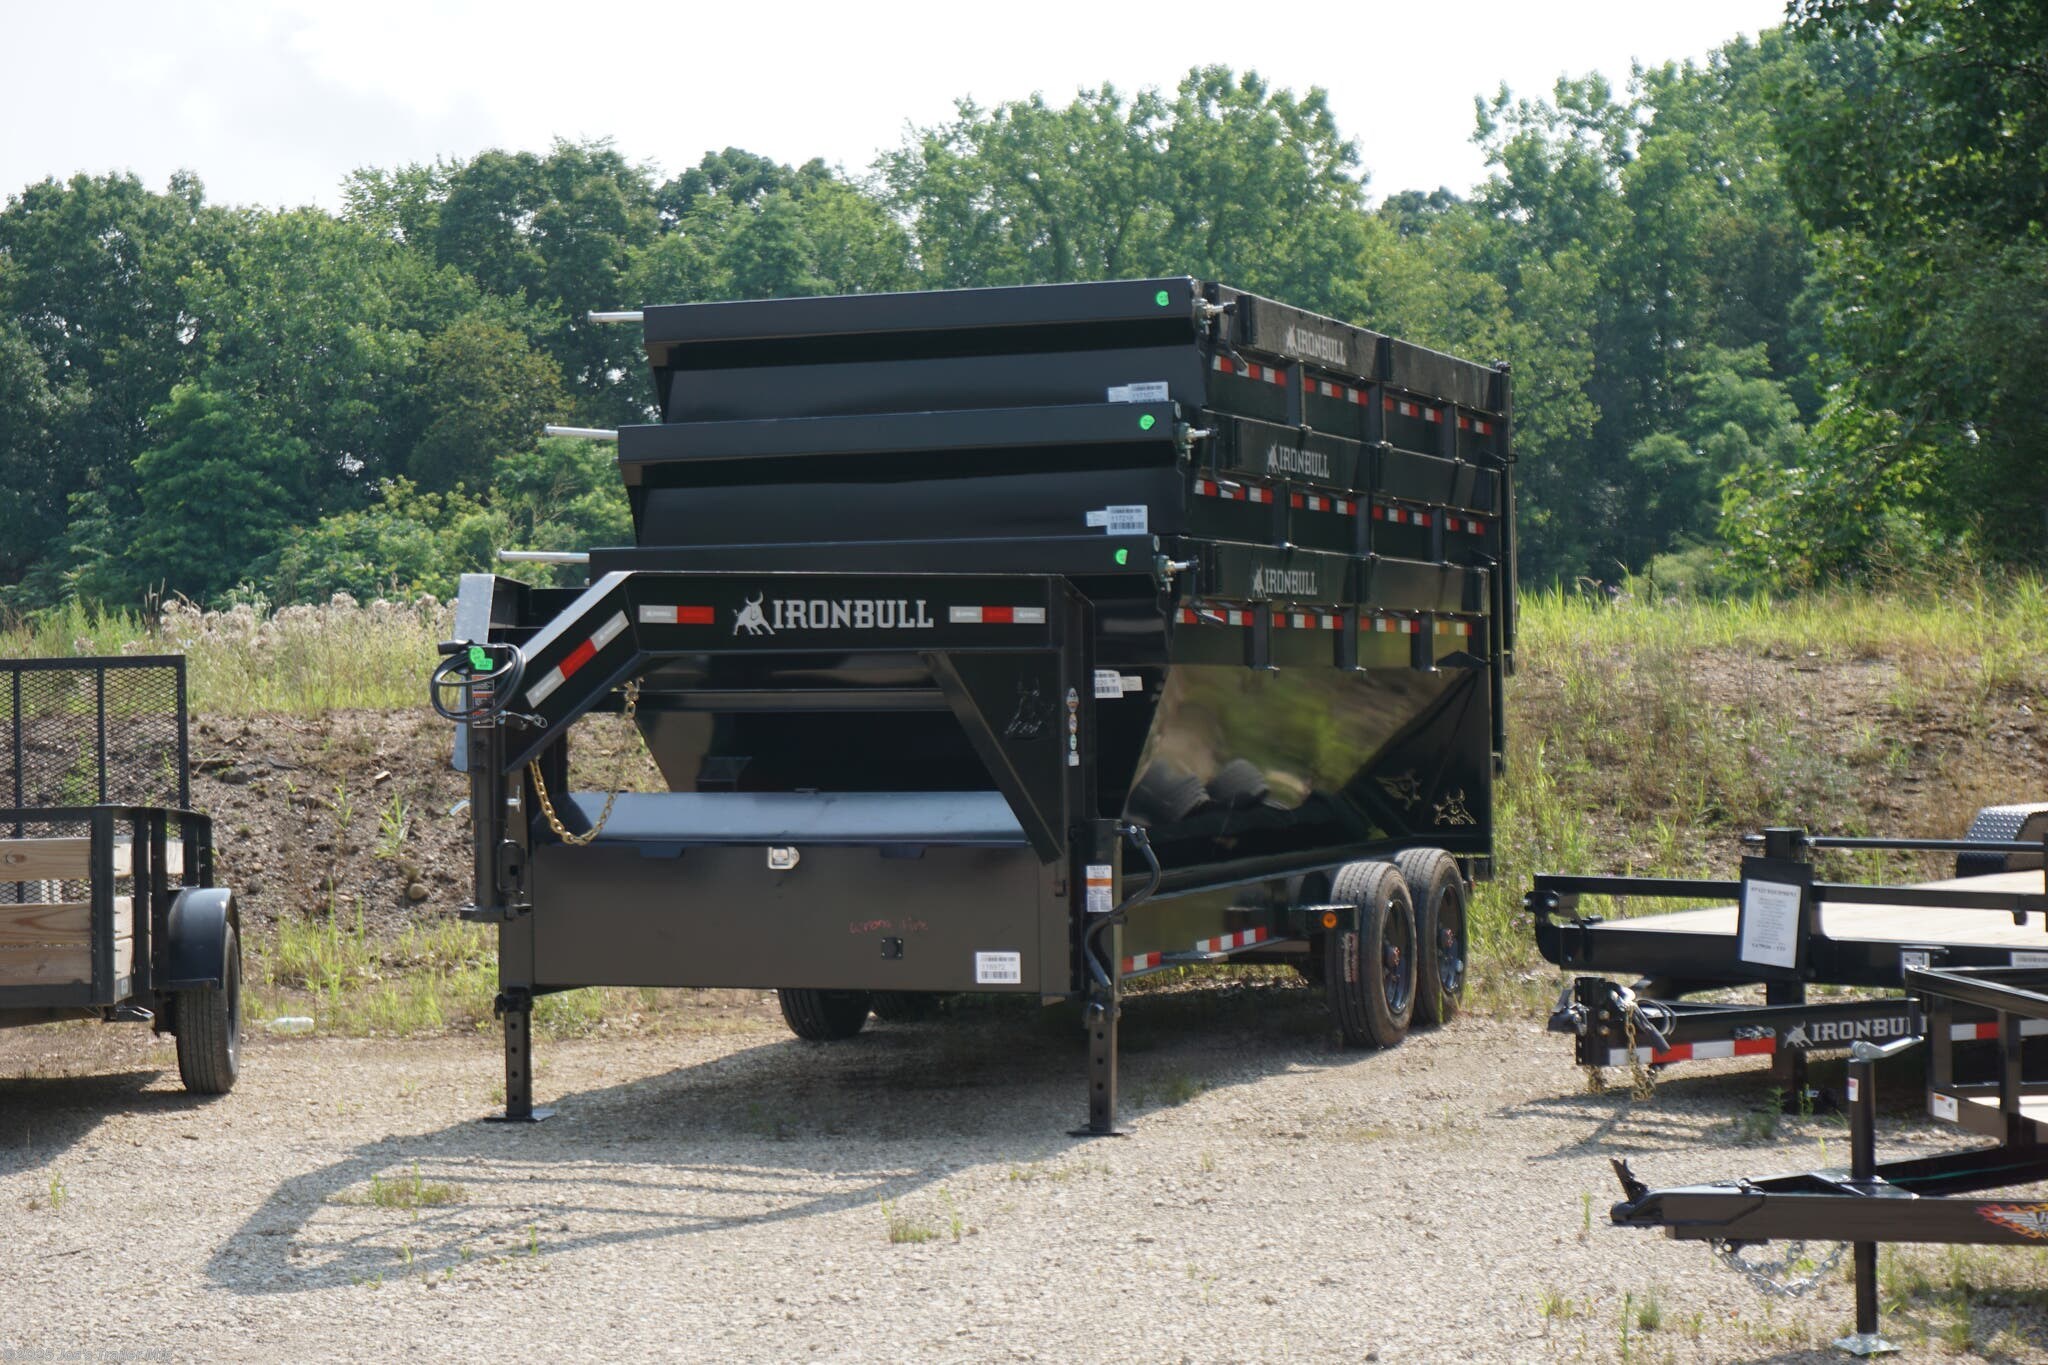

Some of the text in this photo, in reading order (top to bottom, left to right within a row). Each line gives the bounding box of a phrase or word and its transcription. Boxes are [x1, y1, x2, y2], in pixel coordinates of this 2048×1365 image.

[1297, 328, 1346, 366] IRONBULL
[1280, 446, 1330, 478] IRONBULL
[1265, 568, 1318, 595] IRONBULL
[773, 599, 934, 629] IRONBULL
